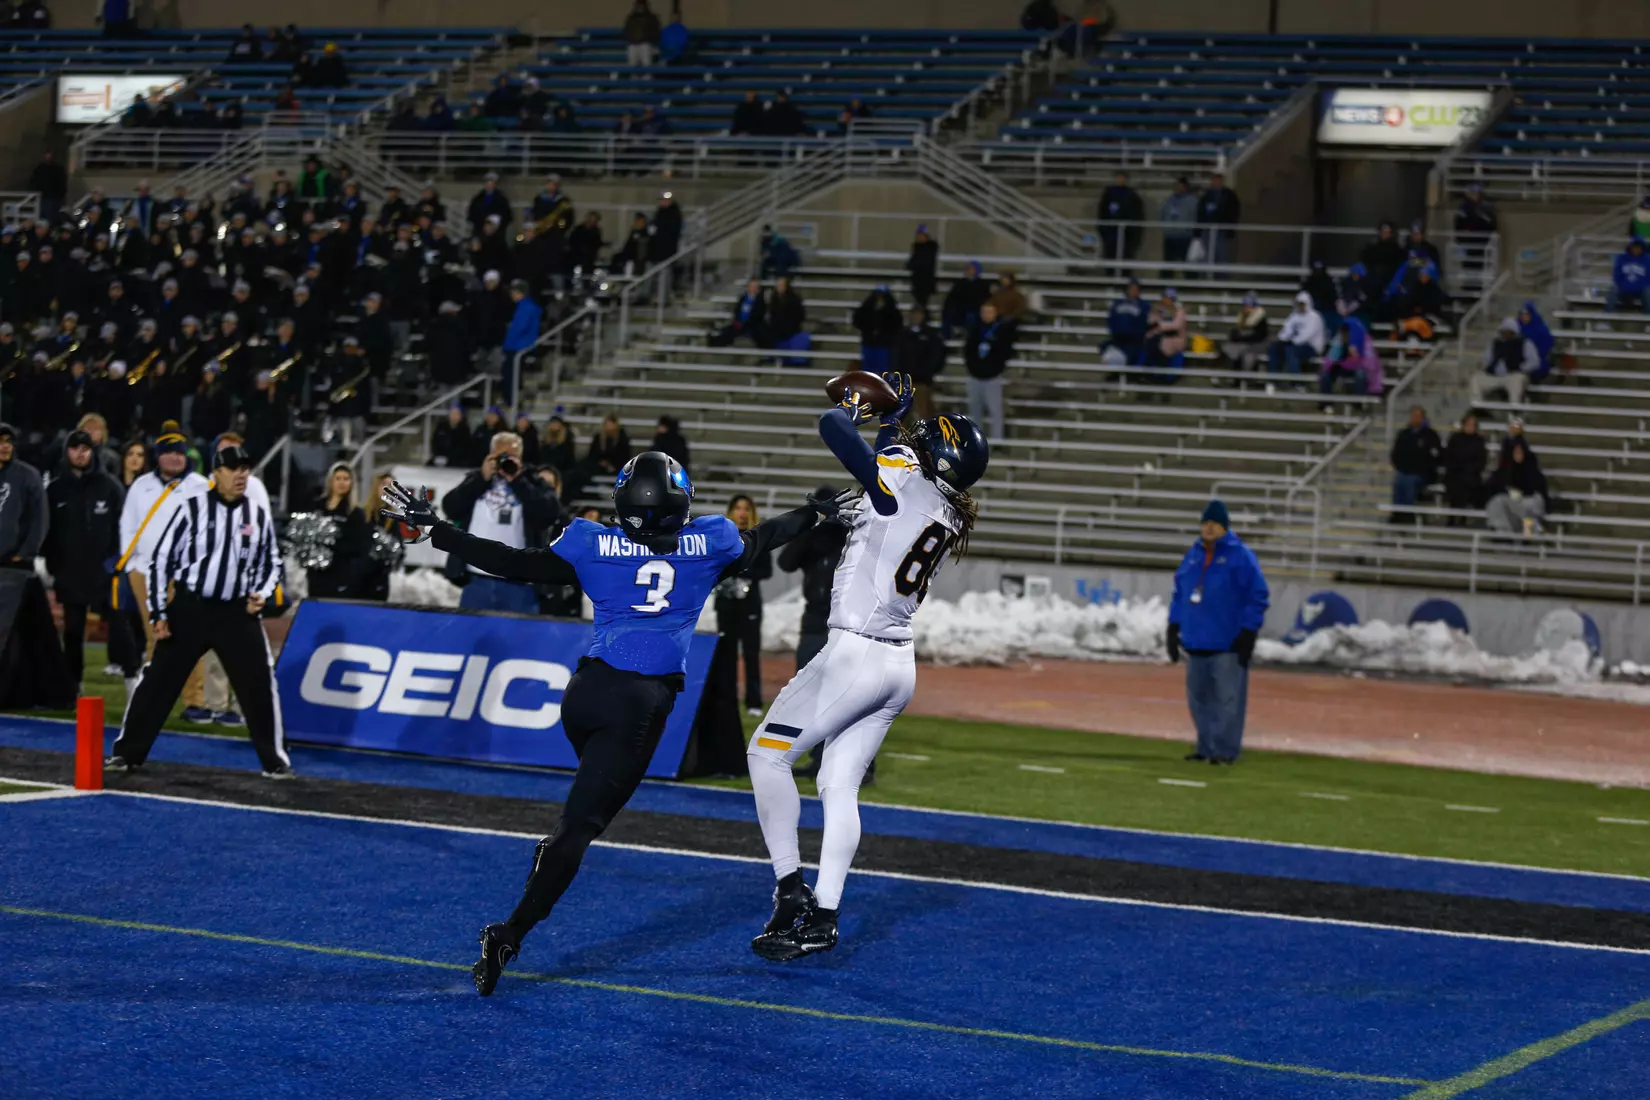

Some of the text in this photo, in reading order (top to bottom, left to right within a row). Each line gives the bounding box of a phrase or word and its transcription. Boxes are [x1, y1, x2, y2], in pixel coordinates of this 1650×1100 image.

[598, 533, 707, 556] WASHITON
[630, 559, 676, 613] 3
[300, 642, 572, 730] GEIC
